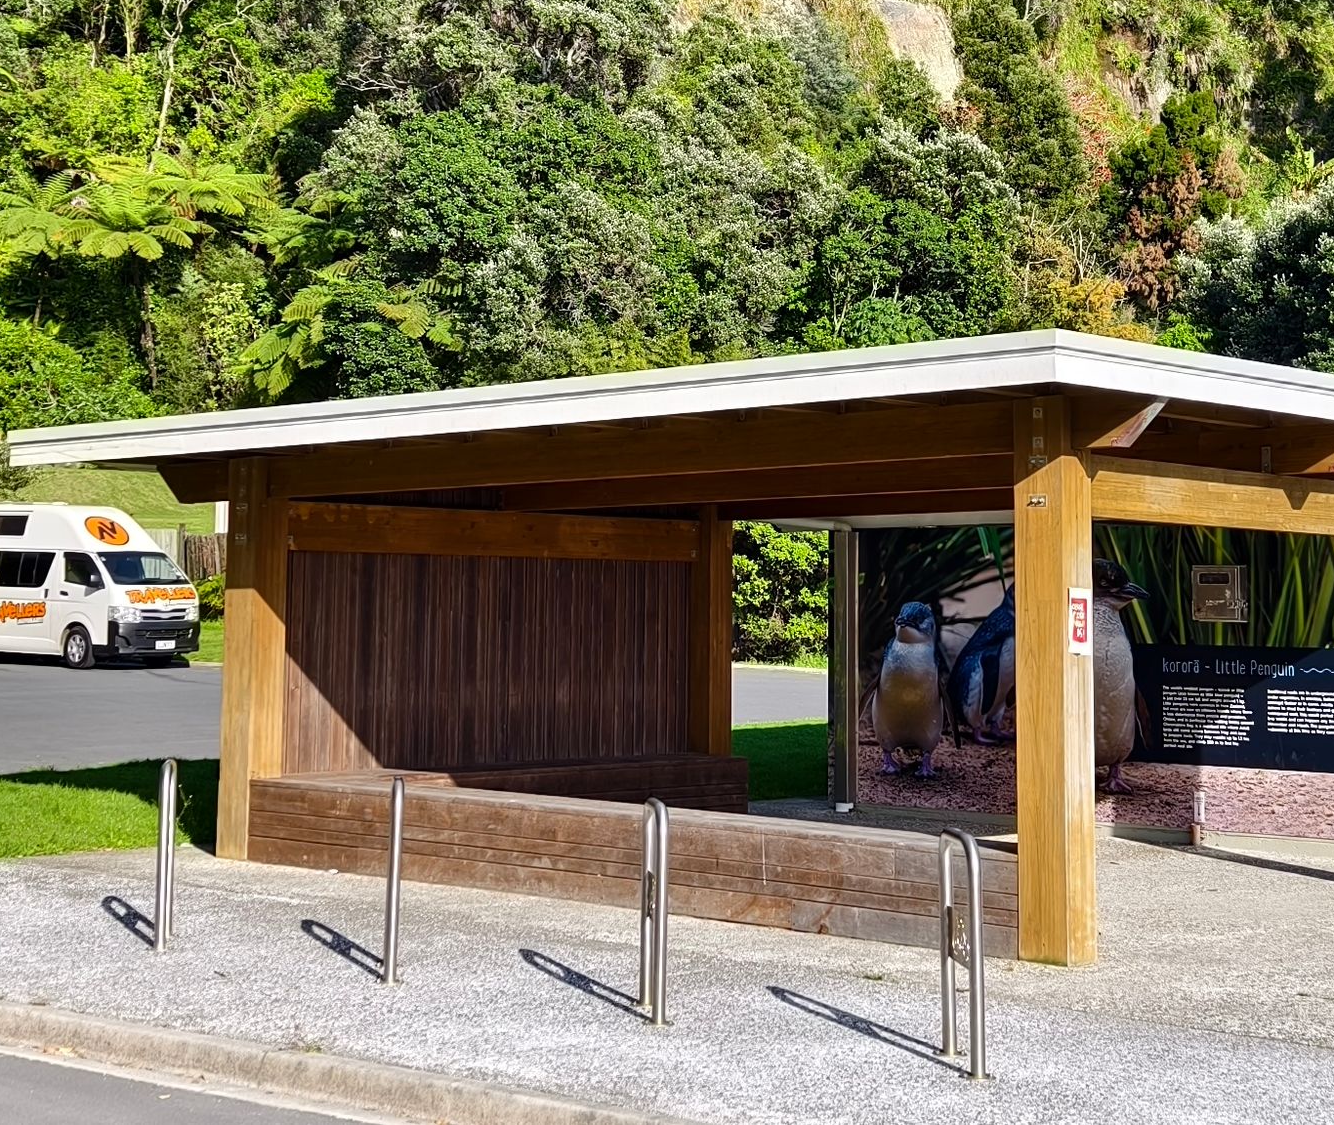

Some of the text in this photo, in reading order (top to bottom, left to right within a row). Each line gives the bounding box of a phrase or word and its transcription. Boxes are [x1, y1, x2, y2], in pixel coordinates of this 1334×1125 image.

[1162, 657, 1199, 673] kororā
[1216, 659, 1246, 675] Little
[1250, 659, 1295, 679] Penguin
